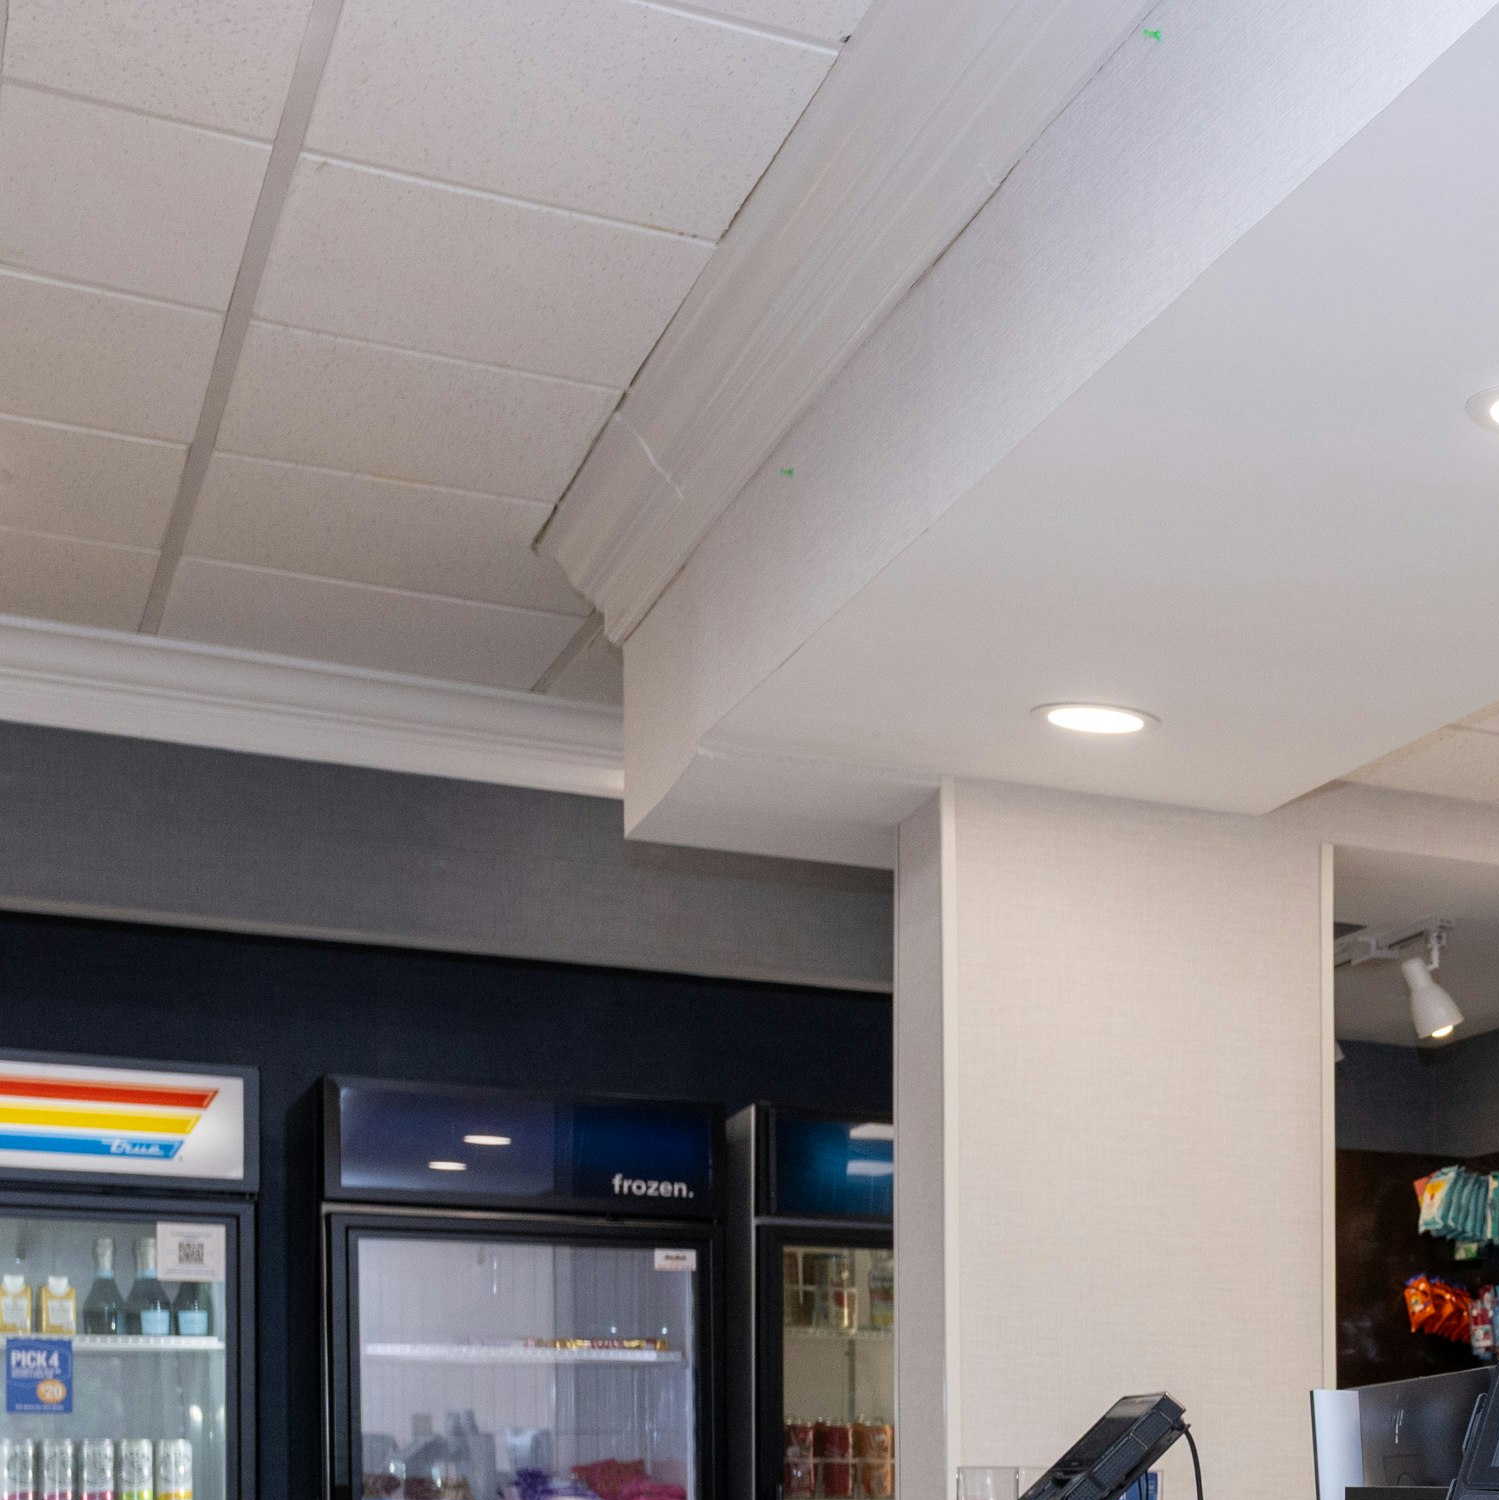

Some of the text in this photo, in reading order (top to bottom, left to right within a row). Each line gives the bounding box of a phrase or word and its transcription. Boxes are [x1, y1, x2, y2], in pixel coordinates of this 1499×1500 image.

[612, 1173, 694, 1198] frozen.
[11, 1350, 60, 1369] PICK 4
